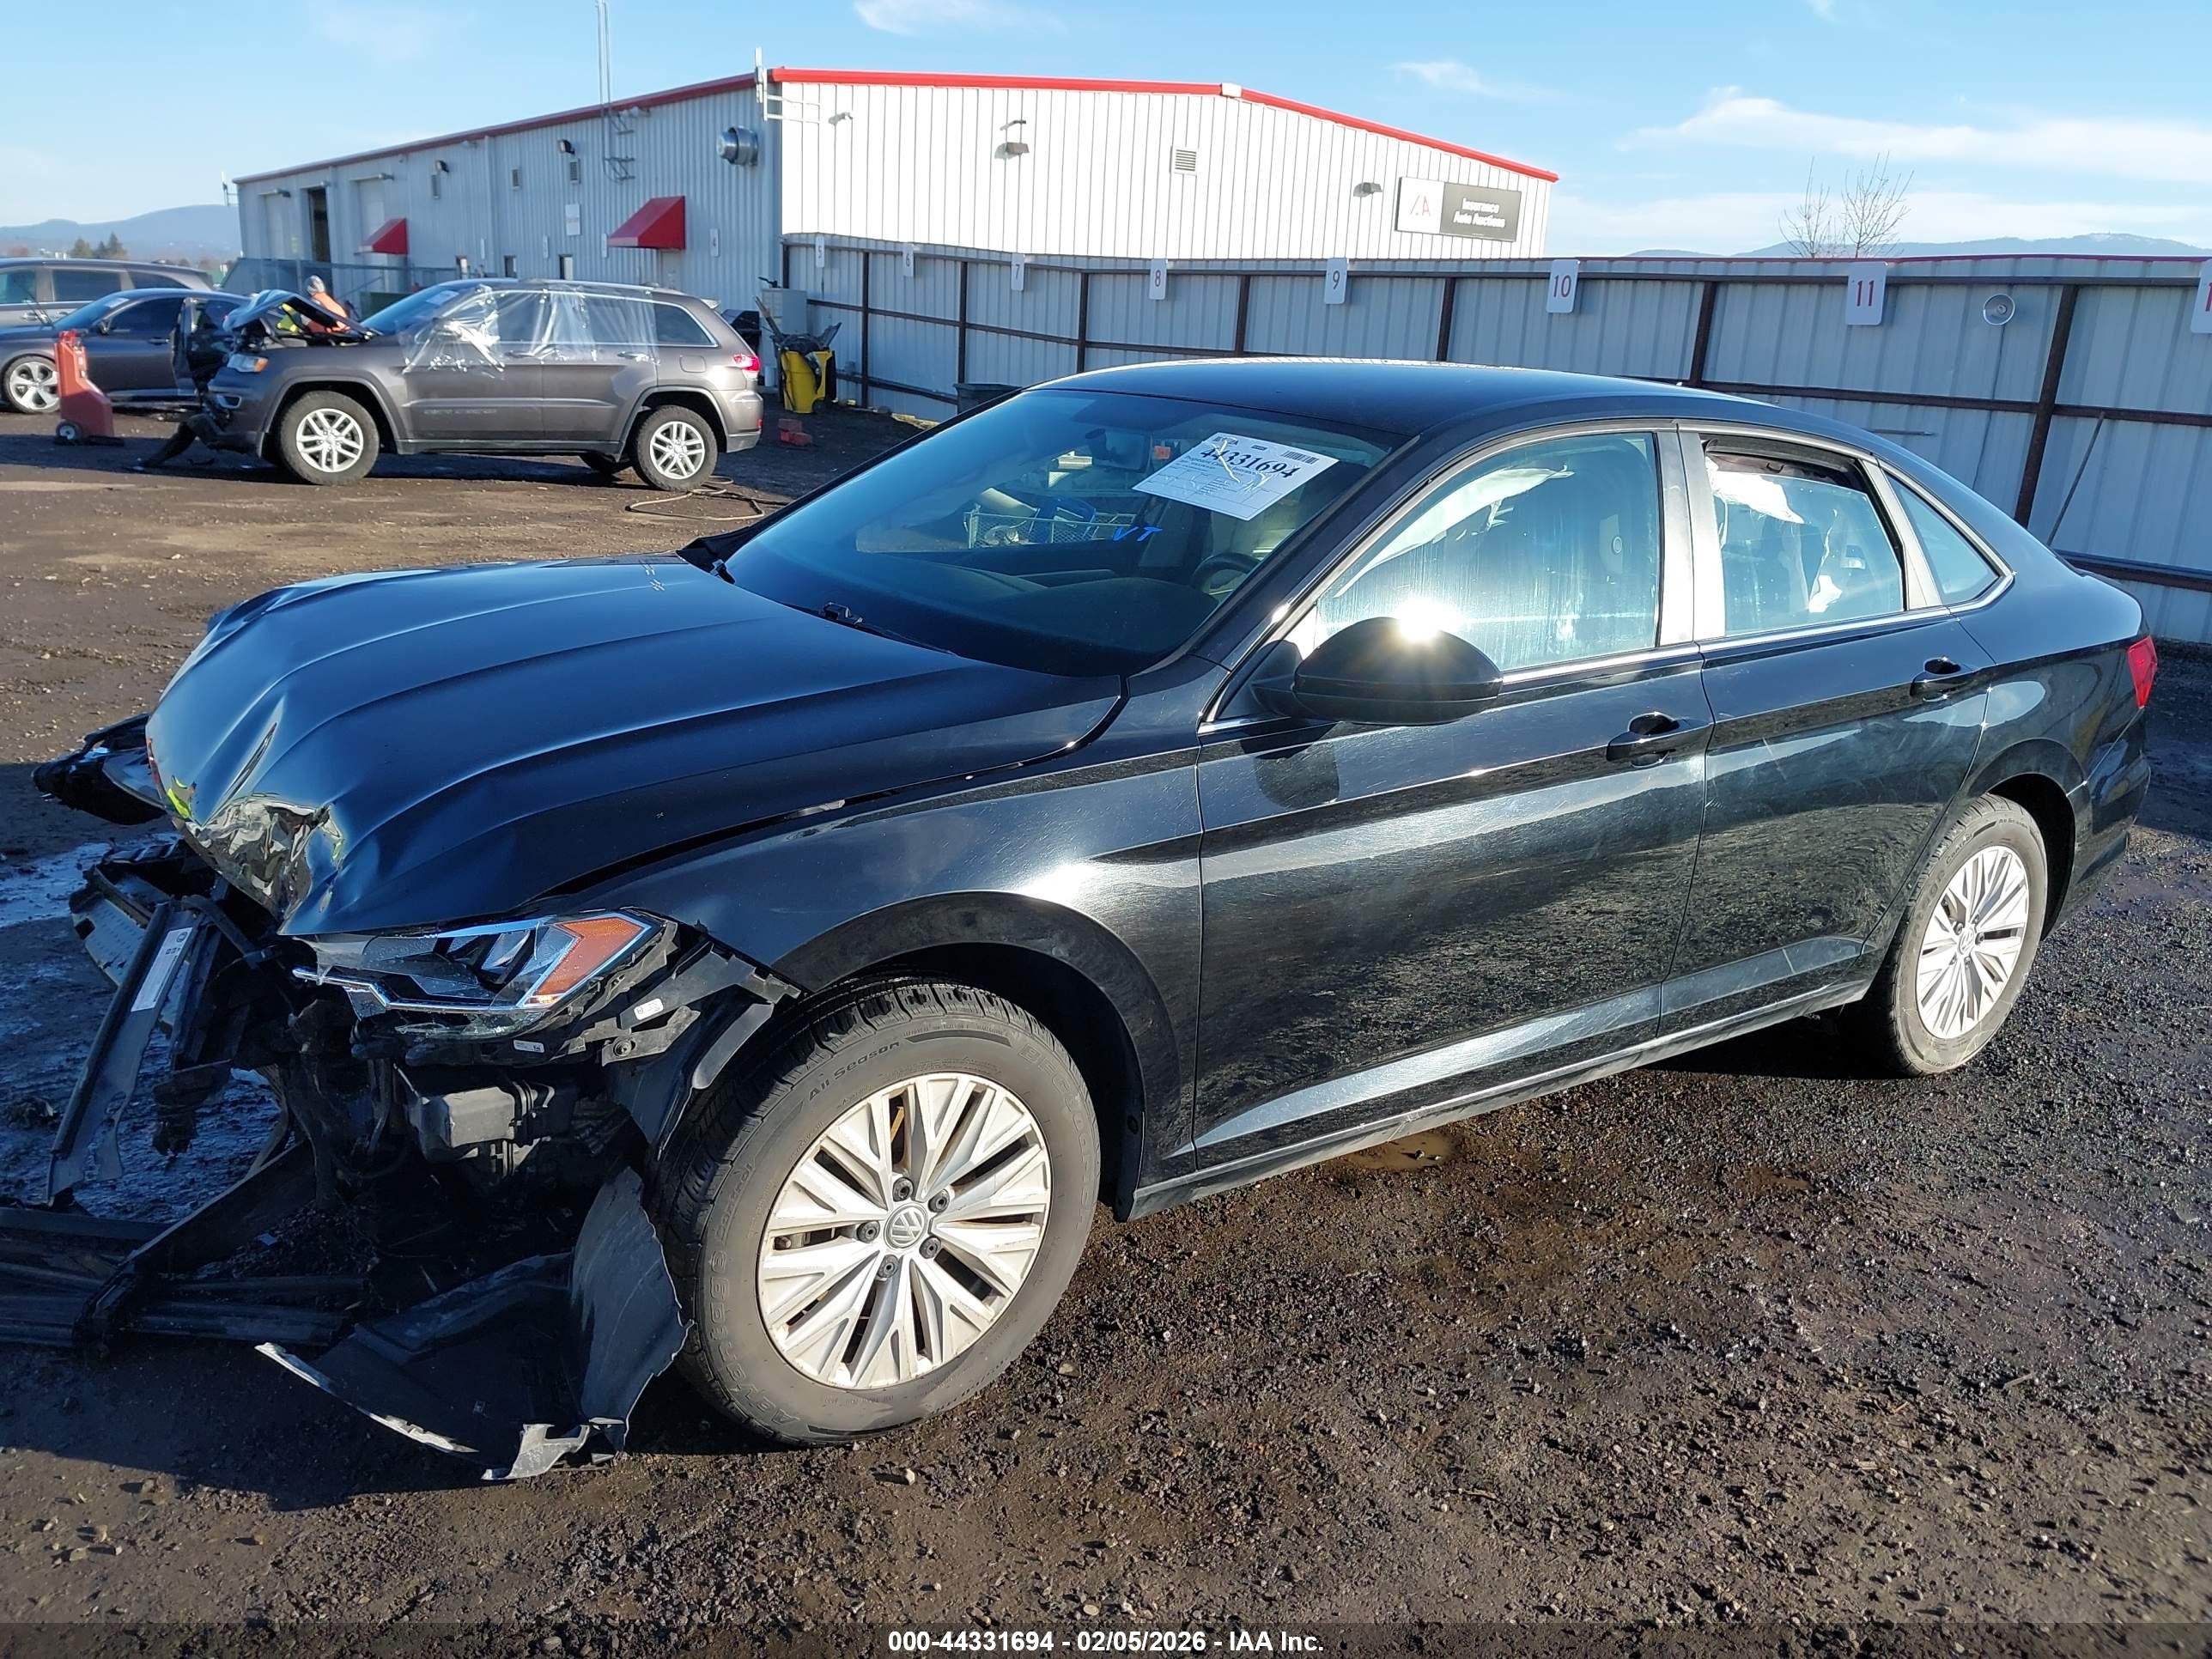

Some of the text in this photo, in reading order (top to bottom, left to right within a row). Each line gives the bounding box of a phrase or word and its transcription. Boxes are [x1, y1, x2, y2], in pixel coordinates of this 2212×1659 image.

[1015, 264, 1020, 280] 7
[1154, 270, 1161, 288] 8
[1333, 270, 1340, 289] 9
[1553, 275, 1571, 298] 10
[1856, 280, 1875, 307] 11
[1200, 447, 1301, 478] 44331694
[834, 1041, 900, 1079] Season
